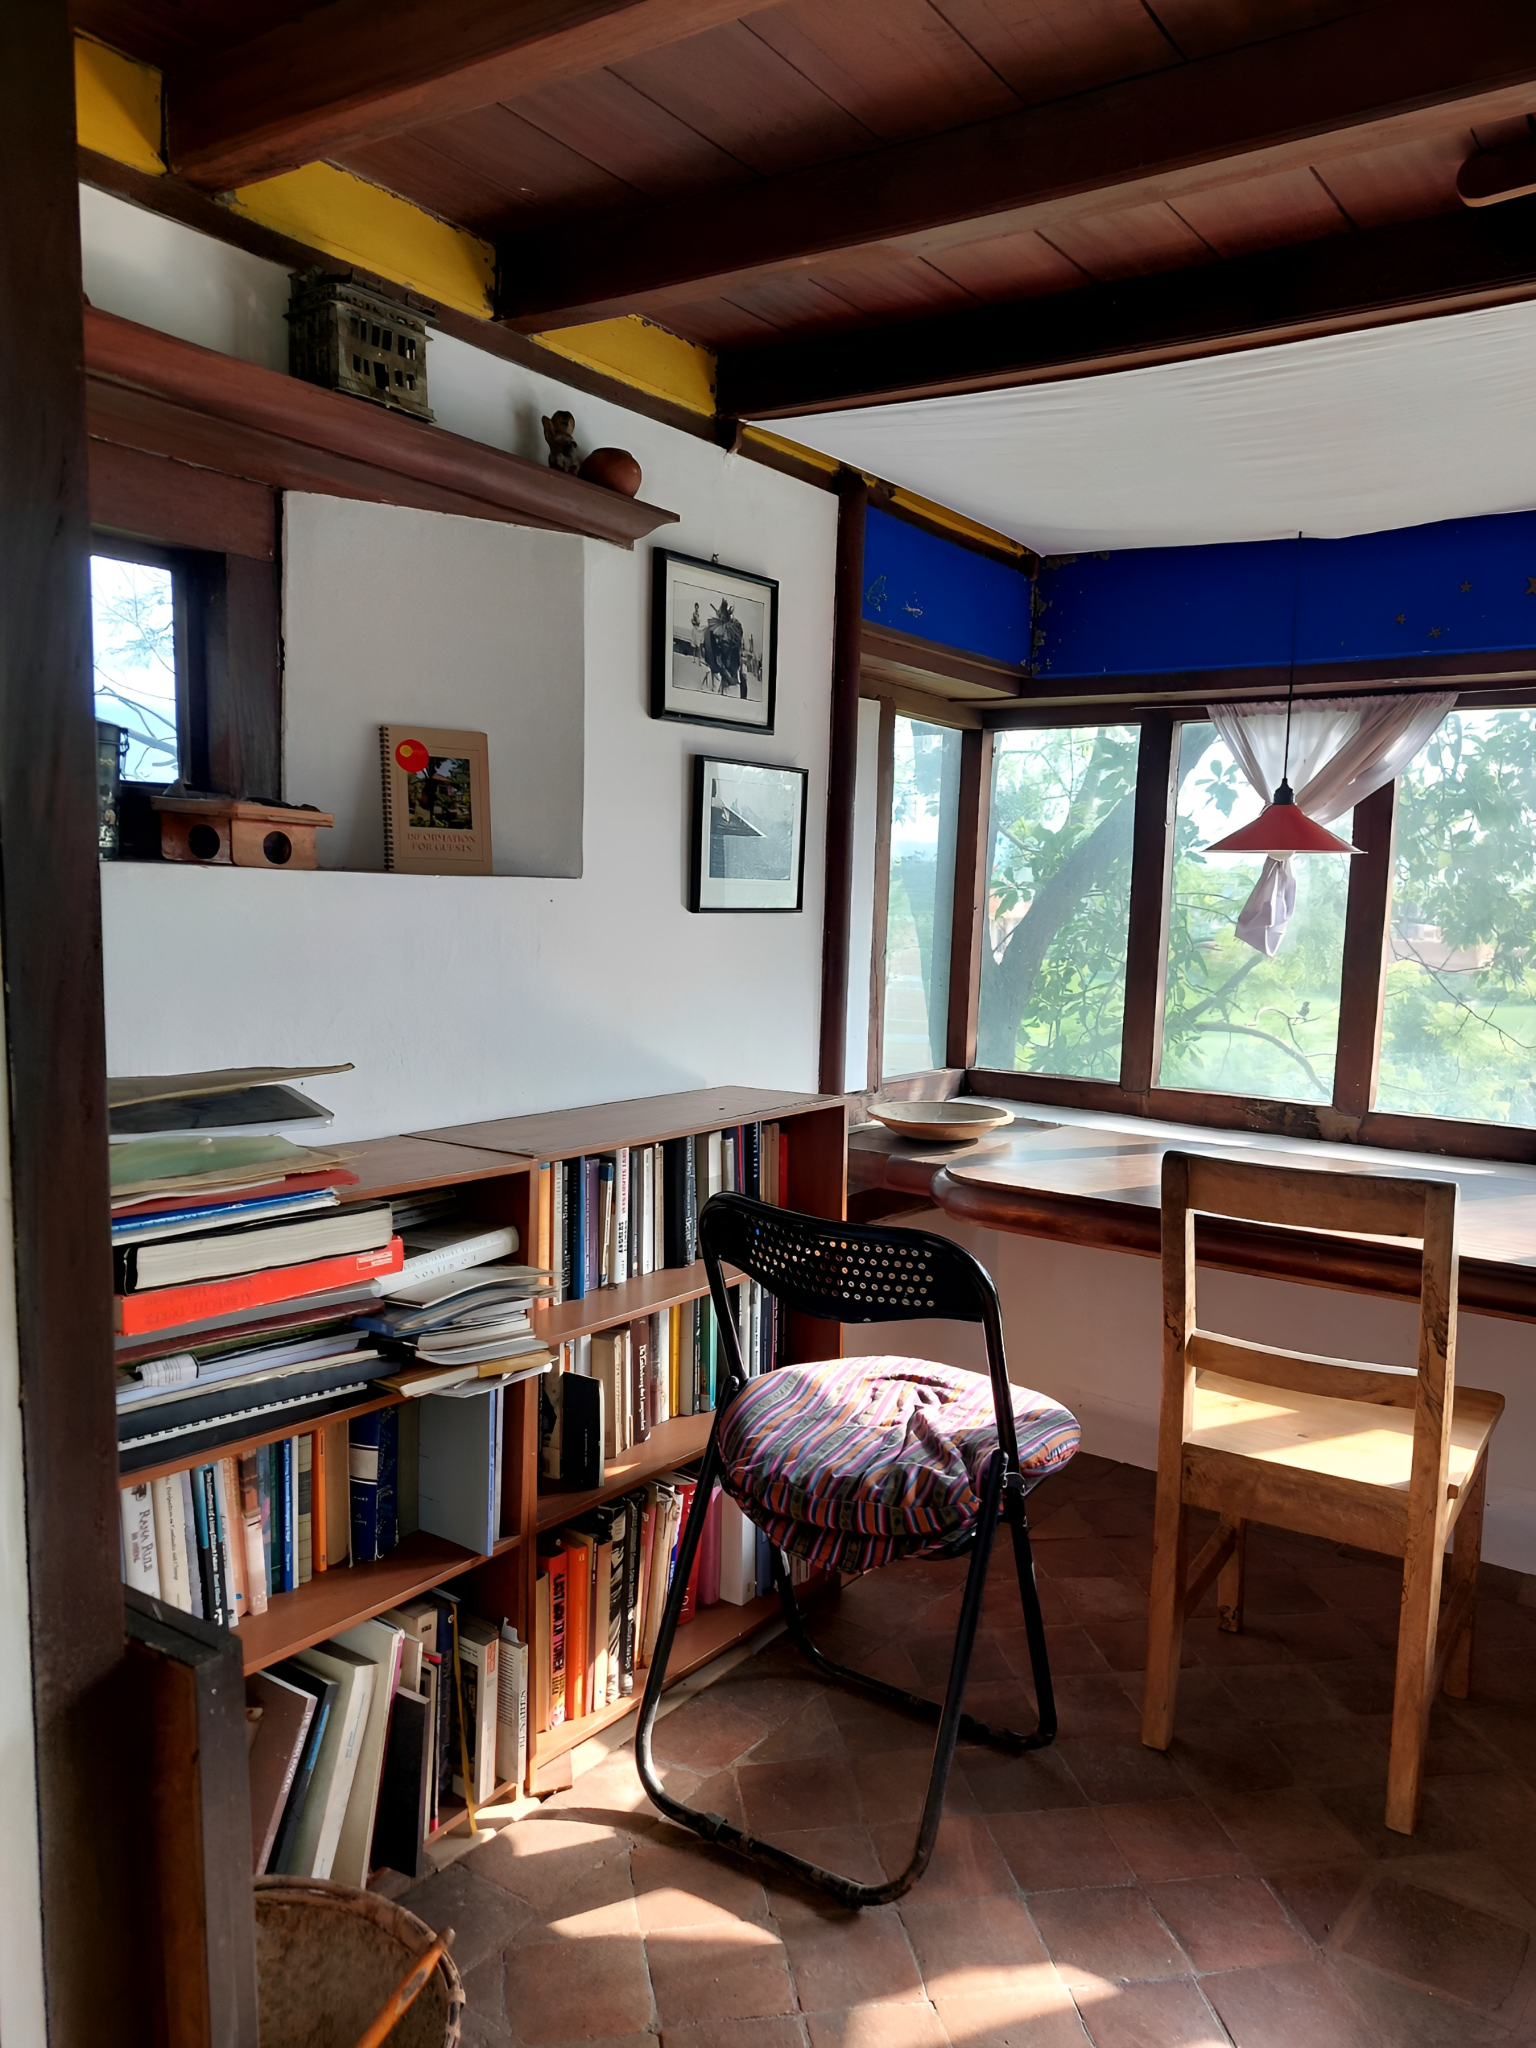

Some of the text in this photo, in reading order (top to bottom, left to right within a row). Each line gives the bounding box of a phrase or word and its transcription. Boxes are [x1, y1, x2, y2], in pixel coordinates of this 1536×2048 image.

[407, 833, 476, 843] INFORMATION
[412, 842, 433, 851] FOR
[139, 1509, 152, 1542] RANA
